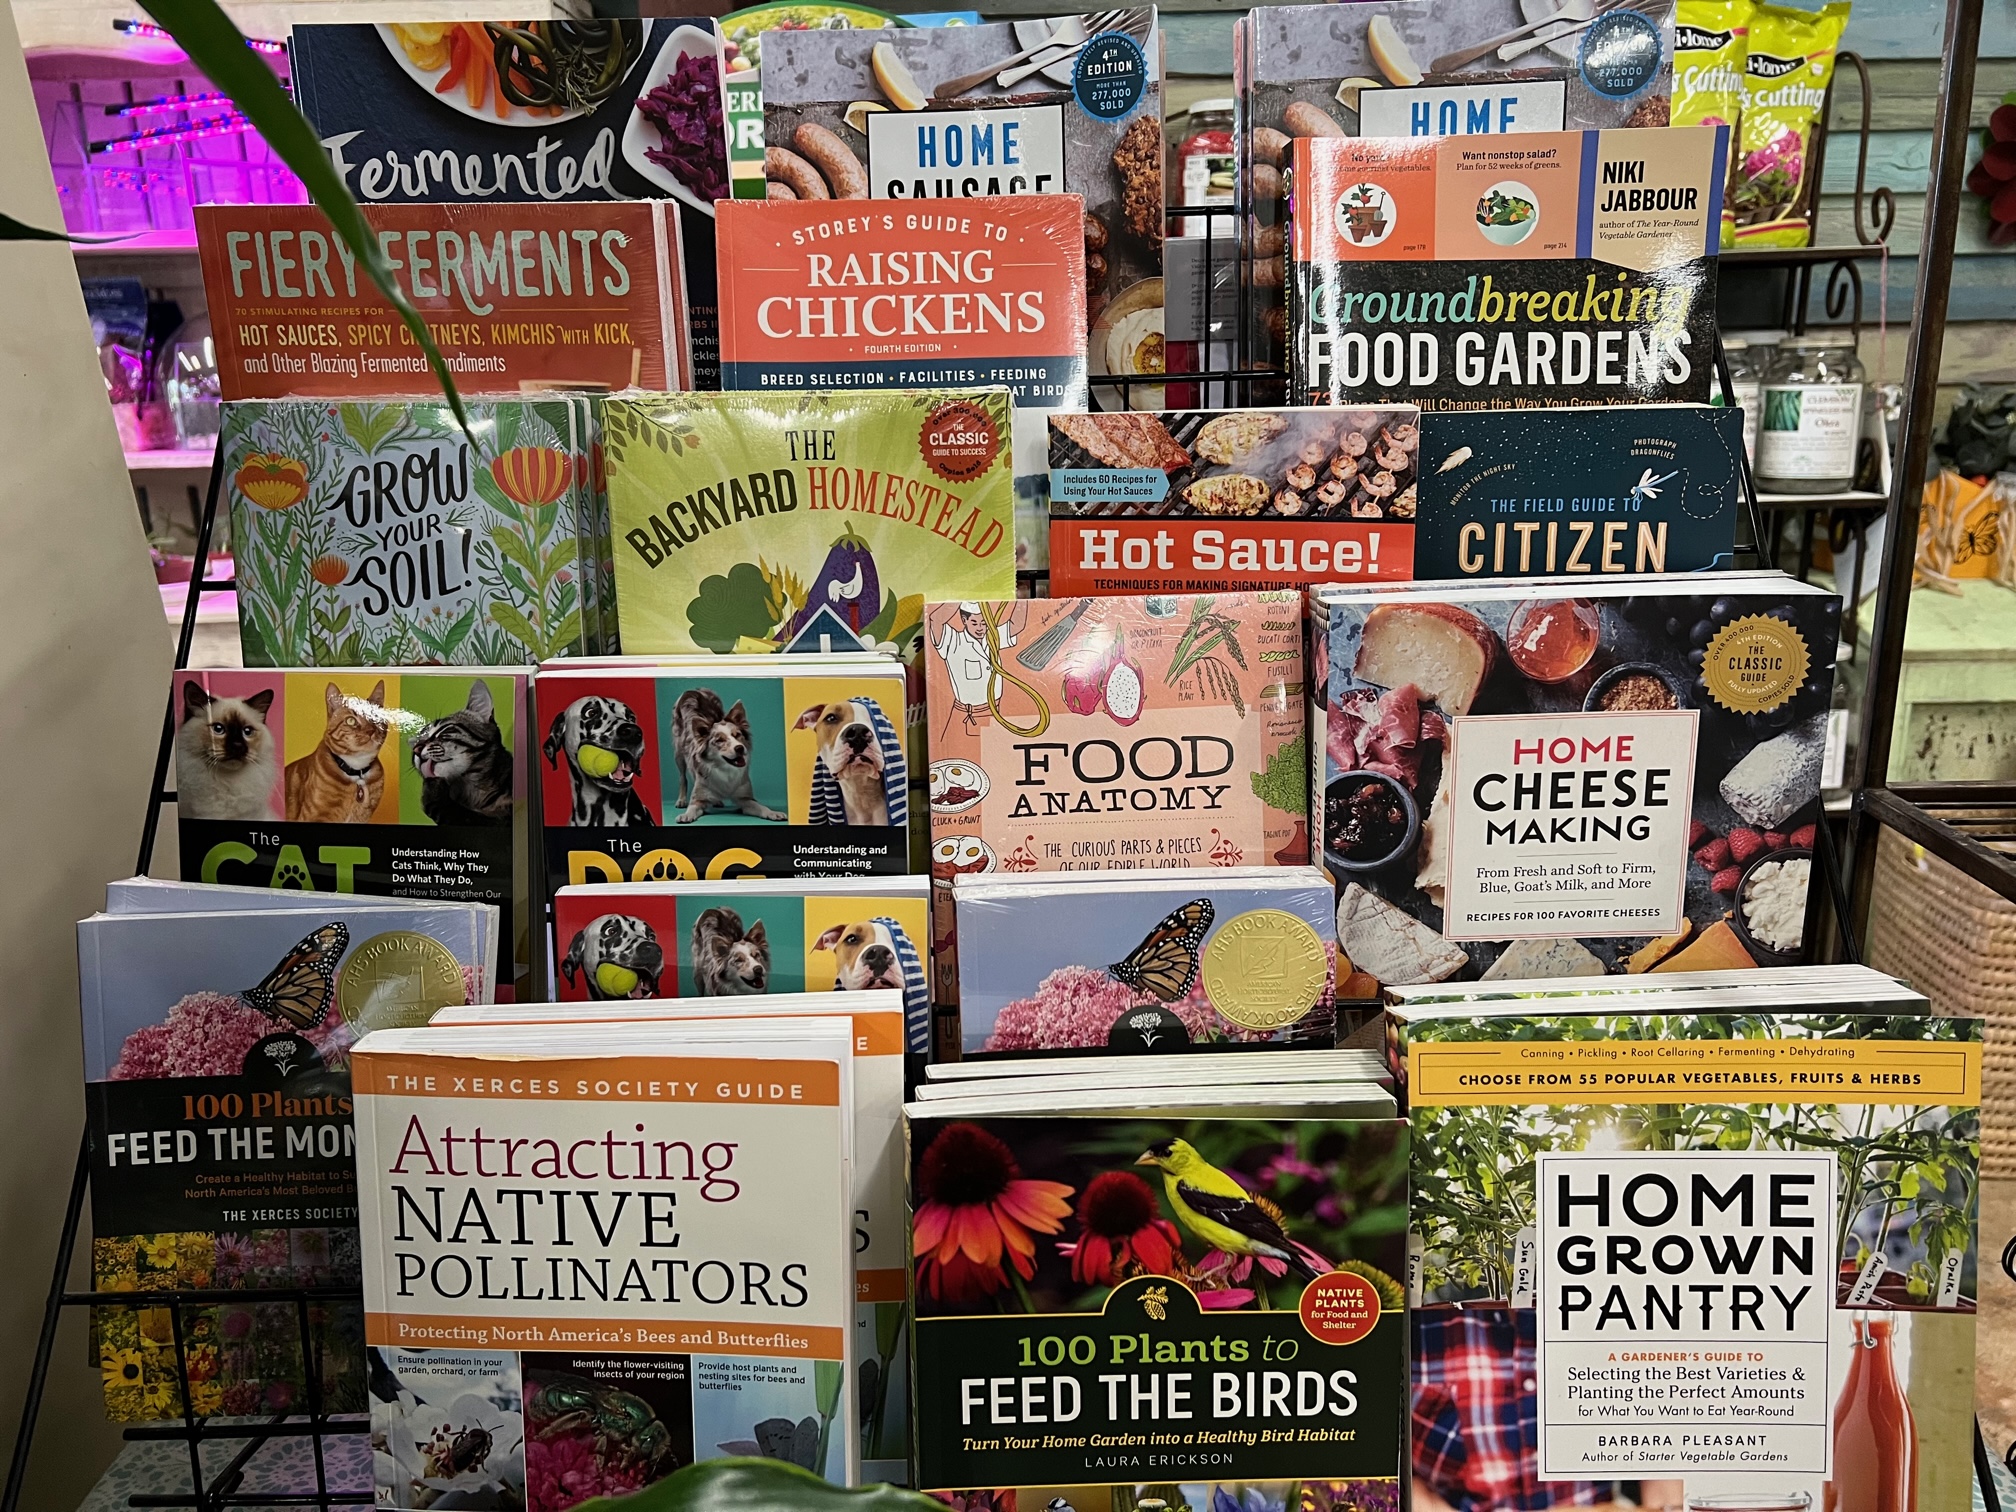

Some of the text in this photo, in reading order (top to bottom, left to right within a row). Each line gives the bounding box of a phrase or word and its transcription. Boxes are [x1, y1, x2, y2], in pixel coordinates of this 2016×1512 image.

[1103, 49, 1117, 61] 4TH
[1088, 60, 1132, 75] EDITION
[1092, 88, 1131, 100] 277,000
[1755, 87, 1825, 112] Cutting
[1100, 100, 1123, 110] SOLD
[918, 123, 1019, 168] HOME
[1462, 149, 1557, 162] Want nonstop salad?
[323, 127, 621, 200] Fermented
[1456, 163, 1474, 171] Plan
[1475, 162, 1486, 170] for
[1499, 162, 1522, 170] weeks
[1533, 162, 1561, 170] greens.
[1603, 161, 1644, 184] NIKI
[1601, 188, 1697, 212] JABBOUR
[793, 214, 1008, 245] STOREY'S GUIDE TO
[1625, 220, 1635, 228] of
[1652, 219, 1699, 228] Year-Round
[1599, 230, 1673, 240] Vegetable Gardener
[227, 231, 357, 298] FIERY
[807, 249, 994, 287] RAISING
[235, 307, 384, 316] 70 STIMULATING RECIPES FOR
[757, 291, 1045, 338] CHICKENS
[1311, 273, 1692, 340] Groundbreaking
[864, 343, 941, 354] FOURTH EDITION
[1456, 330, 1691, 386] GARDENS
[1309, 332, 1440, 387] FOOD
[761, 368, 1046, 386] BREED SELECTION FACILITIES FEEDING
[786, 431, 836, 461] THE
[930, 432, 988, 445] CLASSIC
[1634, 438, 1677, 449] PHOTOGRAPH
[1631, 449, 1675, 460] DRAGONFLIES
[334, 442, 469, 529] GROW
[1064, 475, 1157, 485] Includes 60 Recipes for
[1064, 487, 1153, 497] Using Your Hot Sauces
[1491, 498, 1642, 512] THE FIELD GUIDE TO
[625, 468, 1006, 569] BACKYARD HOMESTEAD
[376, 514, 442, 546] YOUR
[1078, 530, 1381, 574] Hot Sauce!
[1458, 522, 1668, 573] CITIZEN
[347, 530, 474, 616] SOIL!
[1749, 646, 1765, 654] THE
[1268, 664, 1292, 677] FUSILLI
[1729, 657, 1782, 670] CLASSIC
[1179, 680, 1192, 692] RICE
[1741, 673, 1766, 681] GUIDE
[1178, 692, 1194, 701] PLANT
[1514, 736, 1634, 765] HOME
[1013, 736, 1234, 786] FOOD
[1473, 769, 1671, 811] CHEESE
[1008, 785, 1231, 818] ANATOMY
[250, 832, 280, 846] The
[1487, 815, 1650, 845] MAKING
[392, 848, 479, 859] Understanding How
[607, 839, 642, 852] The
[793, 845, 887, 857] Understanding and
[1044, 838, 1201, 857] THE CURIOUS PARTS & PIECES
[392, 861, 488, 873] Cats Think, Why They
[794, 858, 872, 869] Communicating
[1467, 913, 1510, 922] RECIPES
[1537, 912, 1554, 920] 100
[1558, 910, 1610, 919] FAVORITE
[1613, 909, 1660, 917] CHEESES
[387, 1075, 804, 1099] THE XERCES SOCIETY GUIDE
[1459, 1072, 1921, 1085] CHOOSE FROM 55 POPULAR VEGETABLES, FRUITS & HERBS
[183, 1093, 352, 1121] 100 Plants
[107, 1127, 275, 1167] FEED THE
[388, 1114, 741, 1203] Attracting
[1557, 1173, 1815, 1227] HOME
[391, 1186, 680, 1247] NATIVE
[1557, 1235, 1813, 1276] GROWN
[395, 1253, 808, 1308] POLLINATORS
[1317, 1289, 1363, 1297] NATIVE
[1316, 1300, 1364, 1308] PLANTS
[1558, 1285, 1812, 1332] PANTRY
[399, 1323, 808, 1349] Protecting North America's Bees and Butterflies
[1018, 1333, 1298, 1367] 100 Plants to
[1608, 1353, 1763, 1361] A GARDENER'S GUIDE TO
[961, 1370, 1358, 1425] FEED THE BIRDS
[962, 1429, 1355, 1451] Turn Your Home Garden into a Healthy Bird Habitat
[1599, 1436, 1767, 1446] BARBARA PLEASANT
[1085, 1453, 1233, 1468] LAURA ERICKSON
